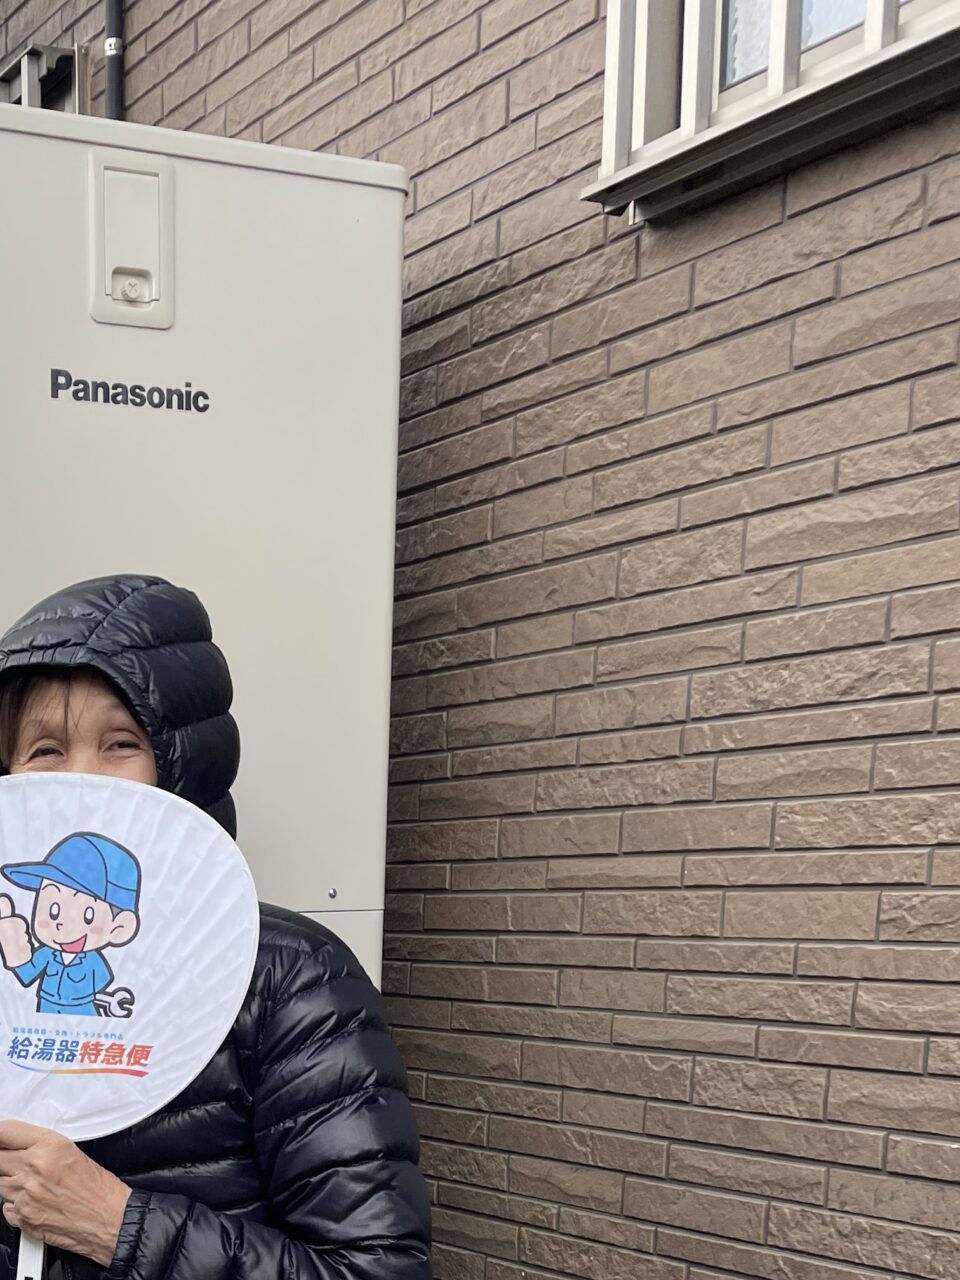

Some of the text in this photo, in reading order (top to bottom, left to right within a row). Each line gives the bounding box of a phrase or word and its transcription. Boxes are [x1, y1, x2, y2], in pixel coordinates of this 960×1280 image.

[50, 367, 210, 413] Panasonic
[7, 1036, 154, 1067] 給湯器特急便
